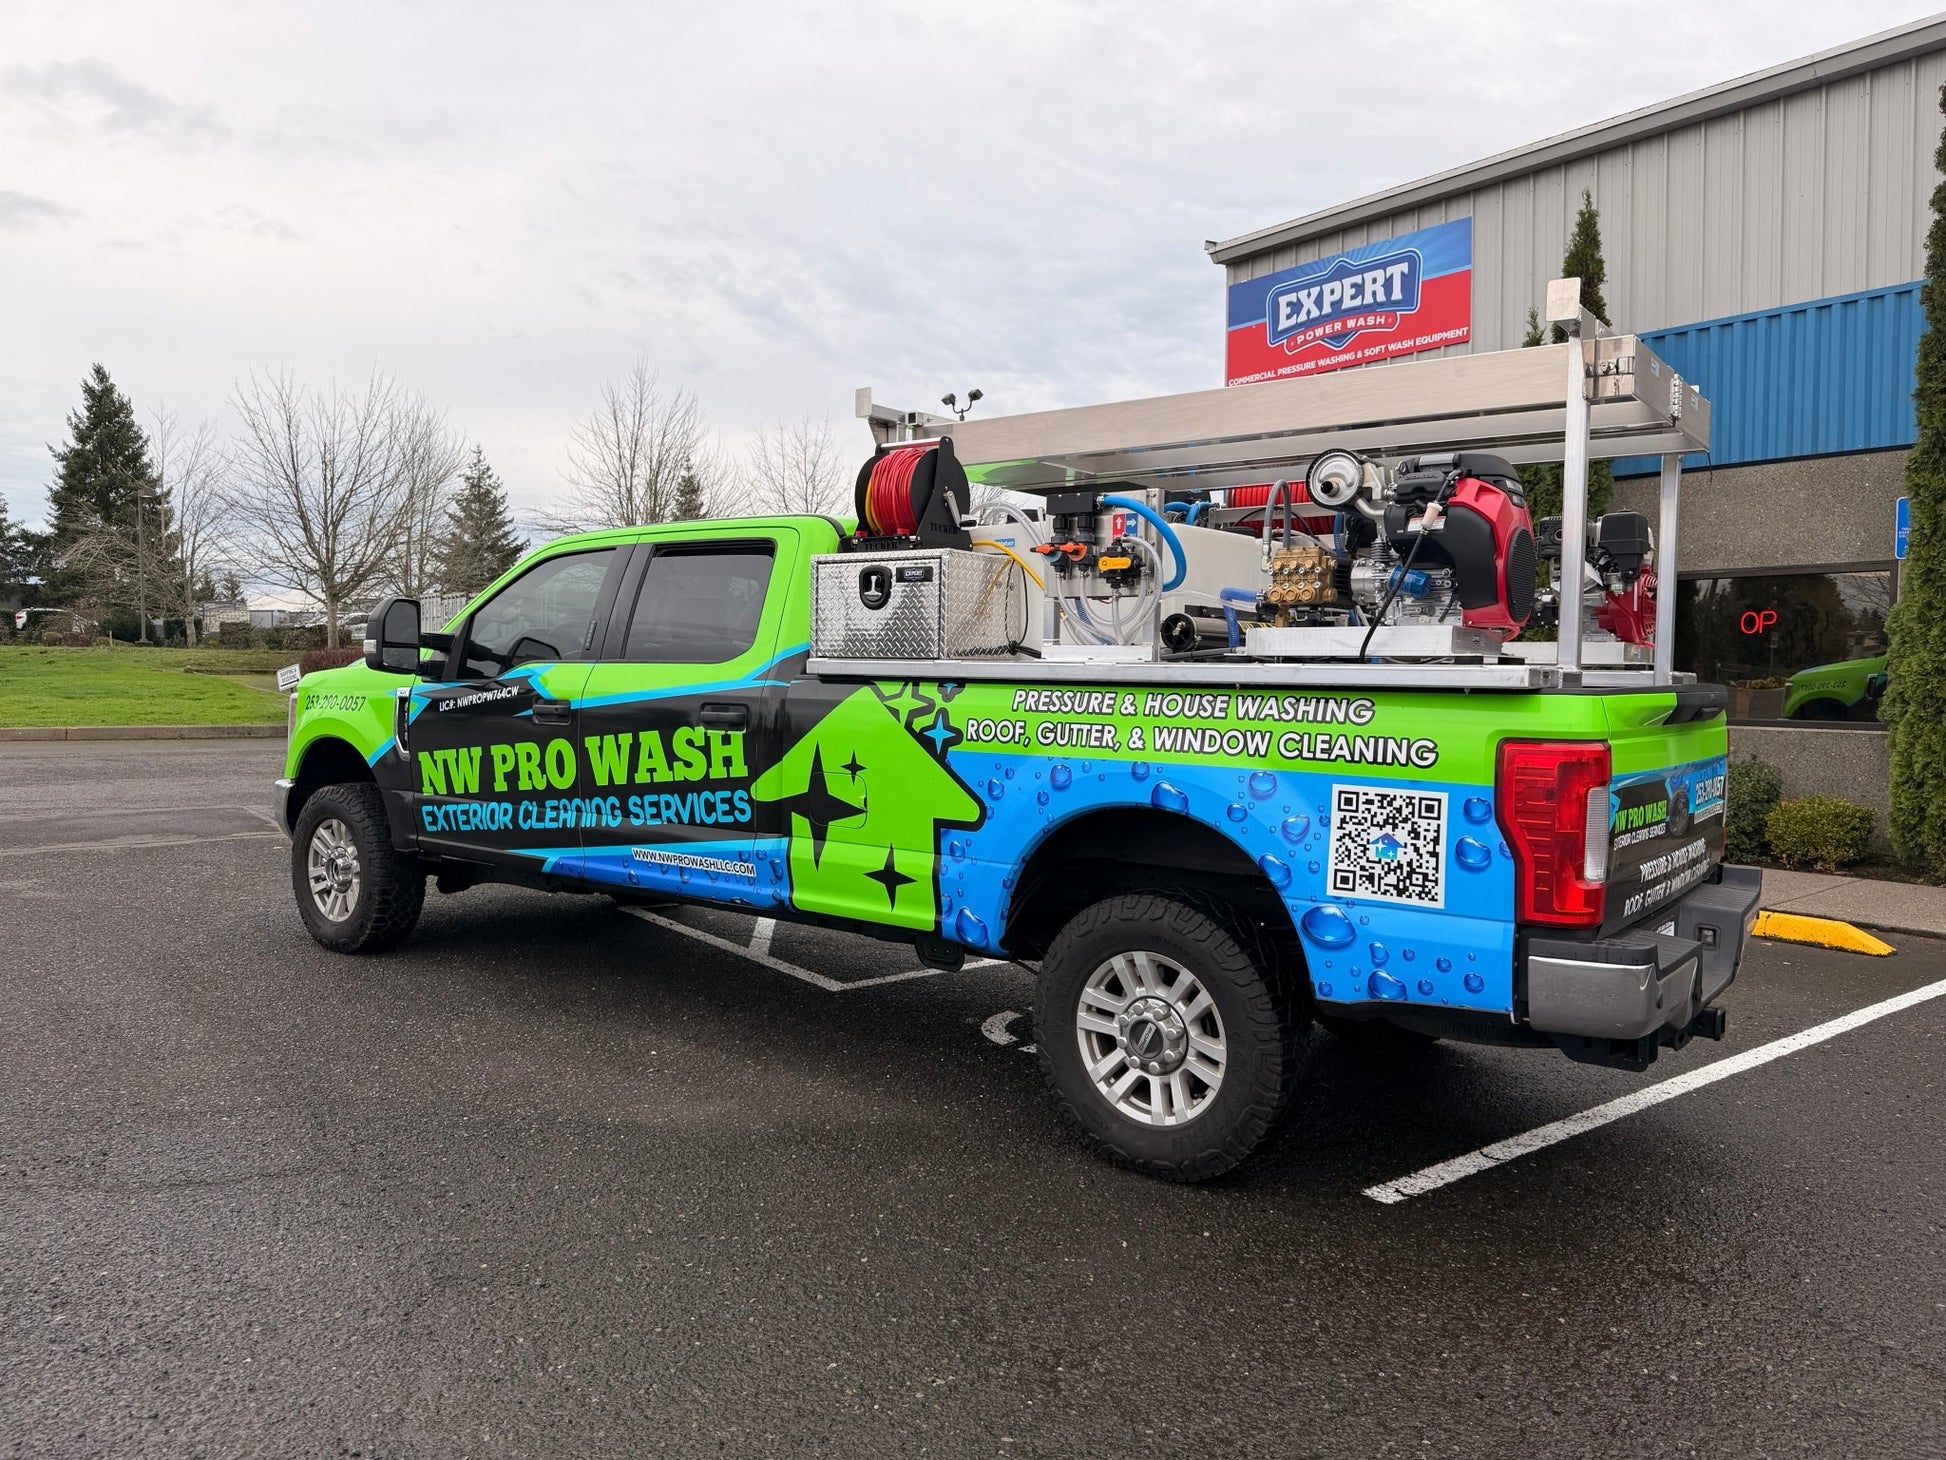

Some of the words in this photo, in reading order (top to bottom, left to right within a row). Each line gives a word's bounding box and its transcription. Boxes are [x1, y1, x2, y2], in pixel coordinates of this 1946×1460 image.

[1277, 262, 1409, 332] EXPERT
[1296, 323, 1342, 345] POWER
[1347, 315, 1385, 328] WASH
[1228, 370, 1276, 387] COMMERCIAL
[1277, 361, 1317, 376] PRESSURE
[1317, 353, 1355, 369] WASHING
[1356, 350, 1363, 359] &
[1364, 345, 1386, 357] SOFT
[1388, 338, 1414, 351] WASH
[1415, 327, 1468, 346] EQUIPMENT
[1740, 610, 1778, 634] OP
[305, 695, 366, 712] 253-290-0057
[439, 699, 456, 712] LIC#:
[457, 685, 519, 708] NWPROPW764CW
[1013, 690, 1116, 714] PRESSURE
[1120, 695, 1136, 715] &
[1144, 694, 1229, 718] HOUSE
[1236, 696, 1375, 724] WASHING
[967, 720, 1030, 746] ROOF,
[1037, 722, 1120, 751] GUTTER,
[1128, 728, 1145, 749] &
[1154, 728, 1270, 756] WINDOW
[1278, 733, 1437, 766] CLEANING
[417, 746, 482, 796] NW
[490, 737, 577, 792] PRO
[584, 726, 748, 787] WASH
[421, 801, 513, 832] EXTERIOR
[518, 797, 623, 830] CLEANING
[628, 789, 751, 826] SERVICES
[1615, 810, 1627, 834] NW
[1628, 805, 1644, 829] PRO
[1645, 800, 1667, 824] WASH
[632, 848, 756, 876] WWW.NWPROWASHLLC.COM
